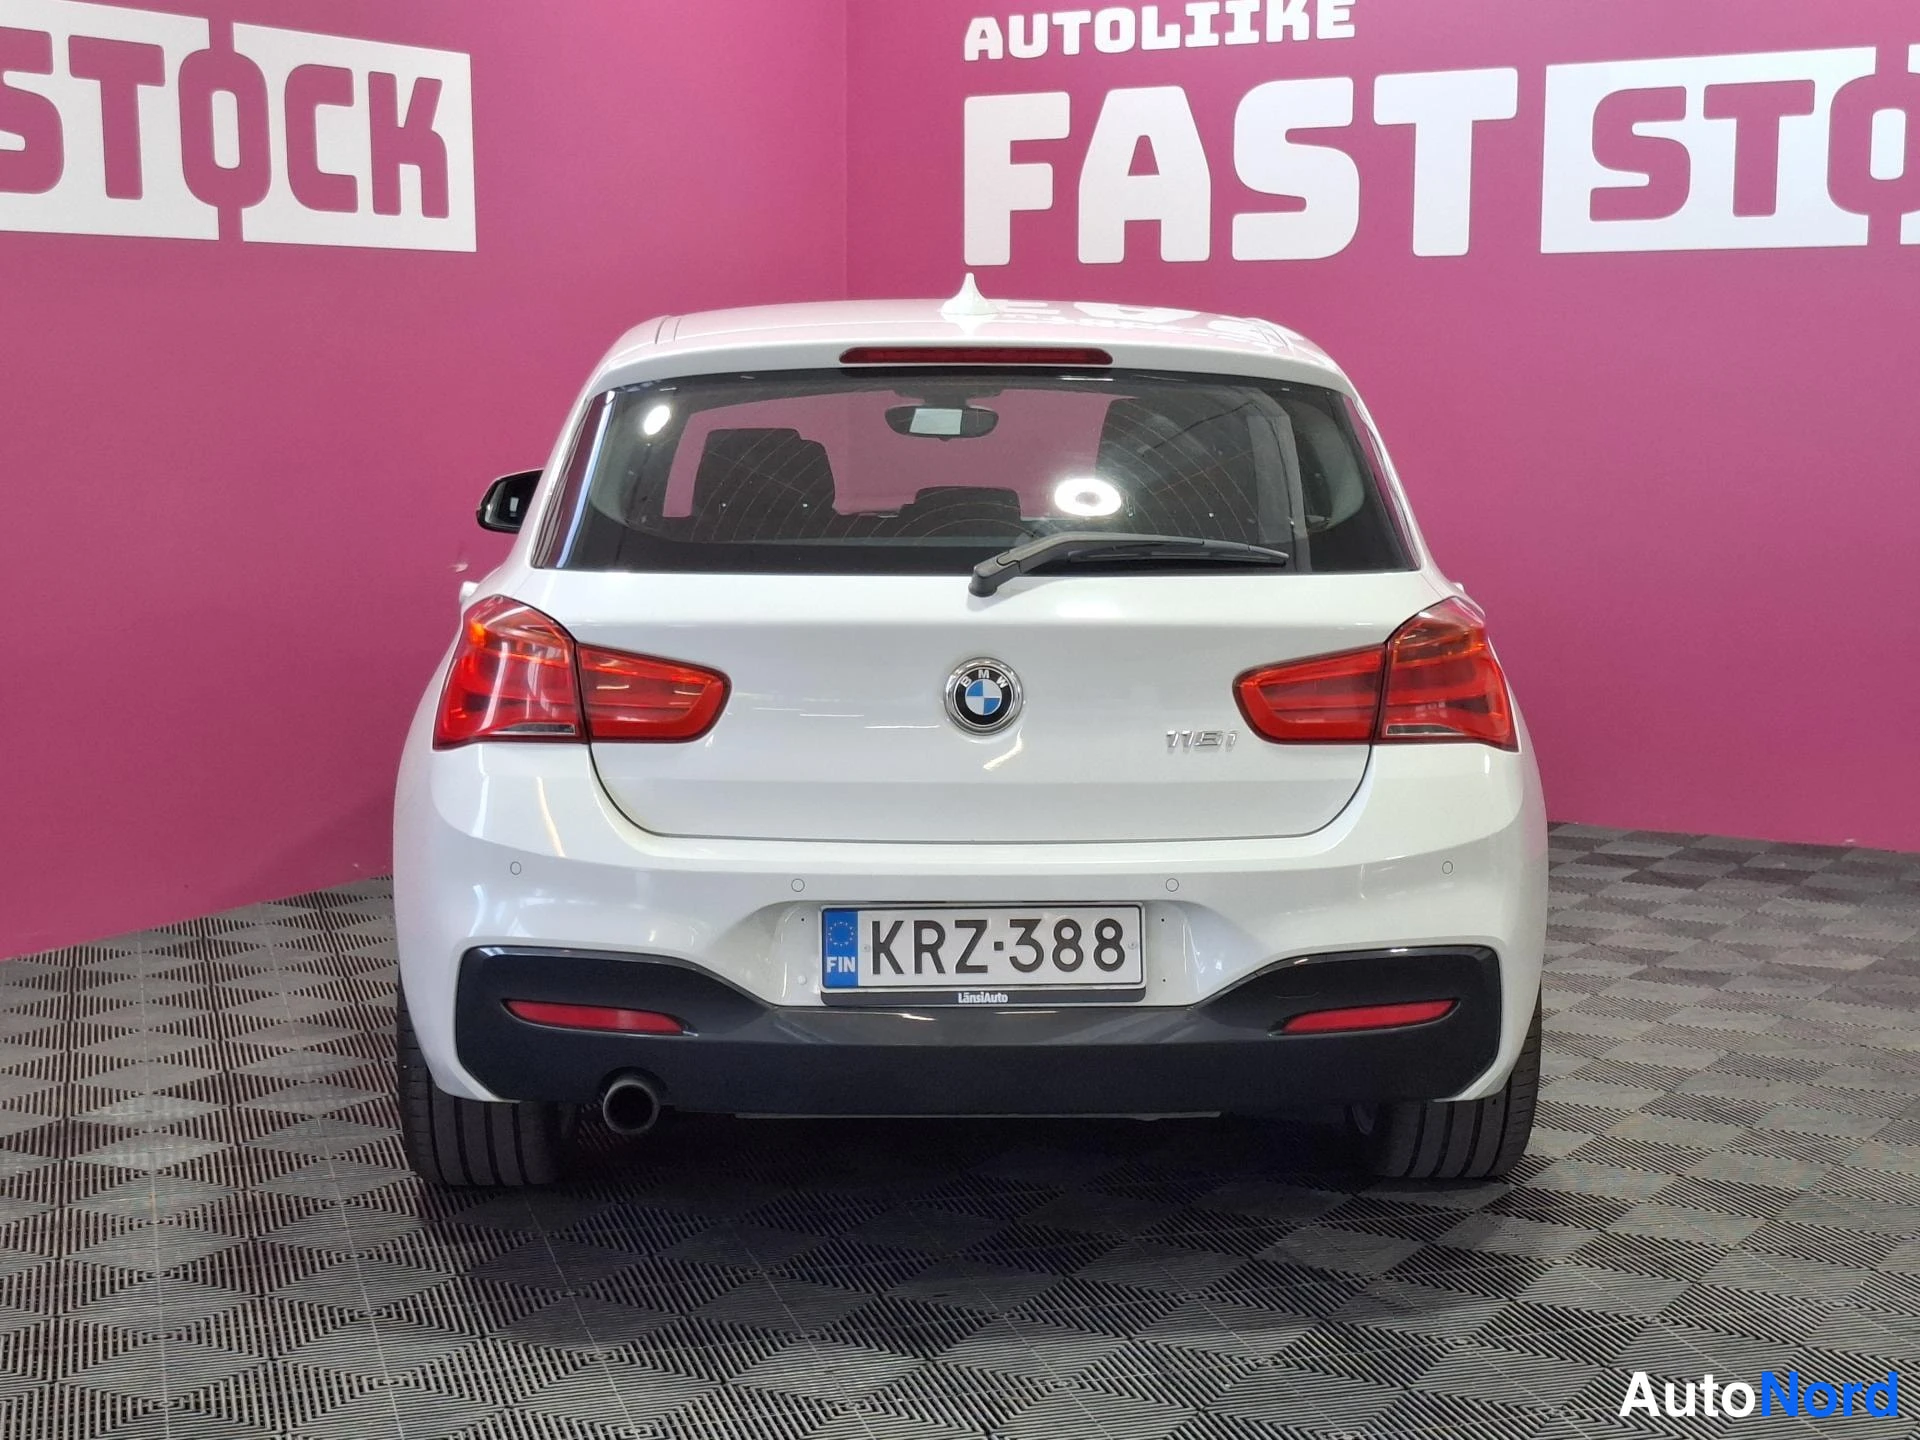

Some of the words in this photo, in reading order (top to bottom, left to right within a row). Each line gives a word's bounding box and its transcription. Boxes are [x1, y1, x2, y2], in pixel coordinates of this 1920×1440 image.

[963, 0, 1356, 62] AUTOLIIKE
[0, 26, 450, 219] STOCK
[963, 67, 1519, 267] FAST
[960, 669, 1009, 689] BMW
[826, 956, 856, 973] FIN
[871, 918, 1126, 975] KRZ-388
[957, 991, 1009, 1004] LänsiAuto
